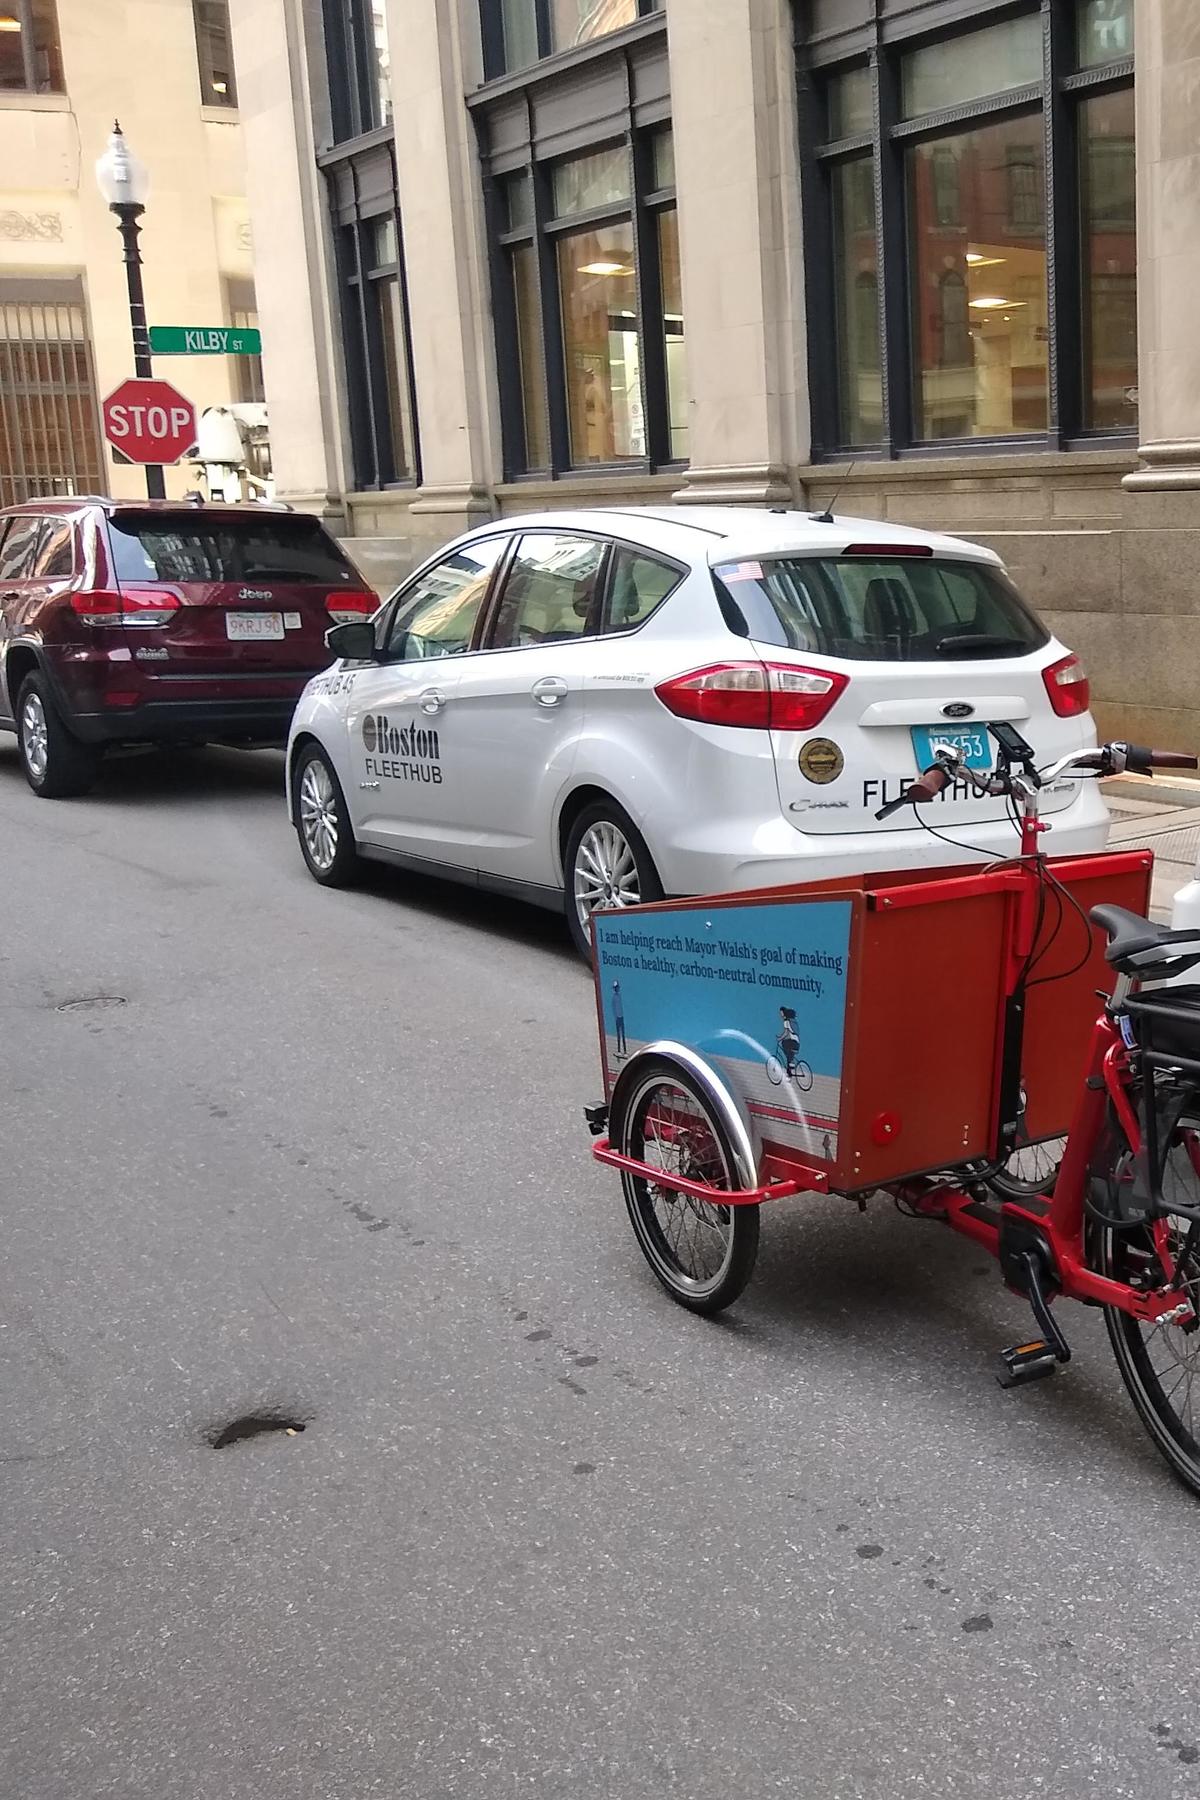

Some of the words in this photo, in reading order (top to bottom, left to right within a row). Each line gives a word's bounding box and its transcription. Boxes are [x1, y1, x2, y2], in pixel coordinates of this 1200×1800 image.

[184, 331, 229, 350] KILBY
[233, 340, 243, 350] ST
[109, 405, 191, 438] STOP
[377, 715, 440, 759] Boston
[365, 758, 442, 784] FLEETHUB
[599, 928, 604, 943] I
[605, 933, 619, 944] am
[620, 930, 656, 953] helping
[656, 935, 683, 951] reach
[684, 938, 717, 958] Mayor
[718, 940, 758, 960] Walsh's
[760, 946, 783, 966] goal
[785, 947, 797, 965] of
[800, 950, 843, 976] making
[602, 951, 632, 969] Boston
[634, 957, 640, 969] a
[640, 954, 679, 978] healthy,
[680, 960, 757, 984] carbon-neutral
[759, 973, 825, 998] community.
